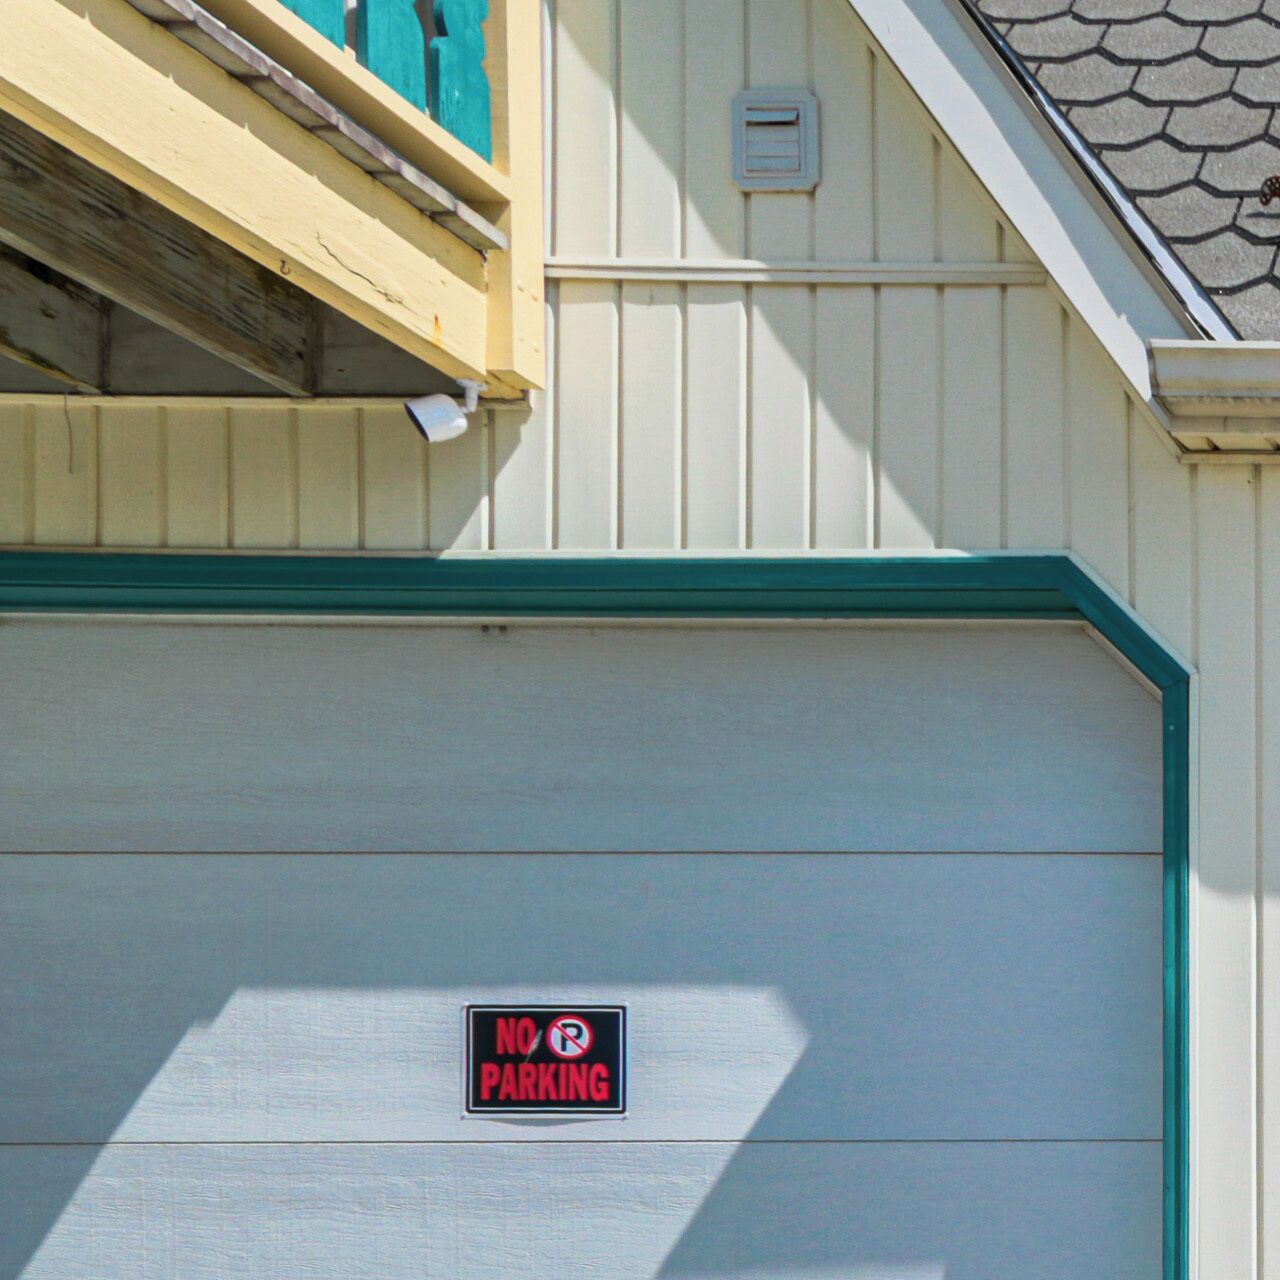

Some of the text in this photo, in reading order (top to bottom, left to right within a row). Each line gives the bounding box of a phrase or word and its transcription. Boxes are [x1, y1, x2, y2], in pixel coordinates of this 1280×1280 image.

[496, 1017, 537, 1055] NO
[560, 1023, 583, 1051] P
[480, 1063, 610, 1101] PARKING
